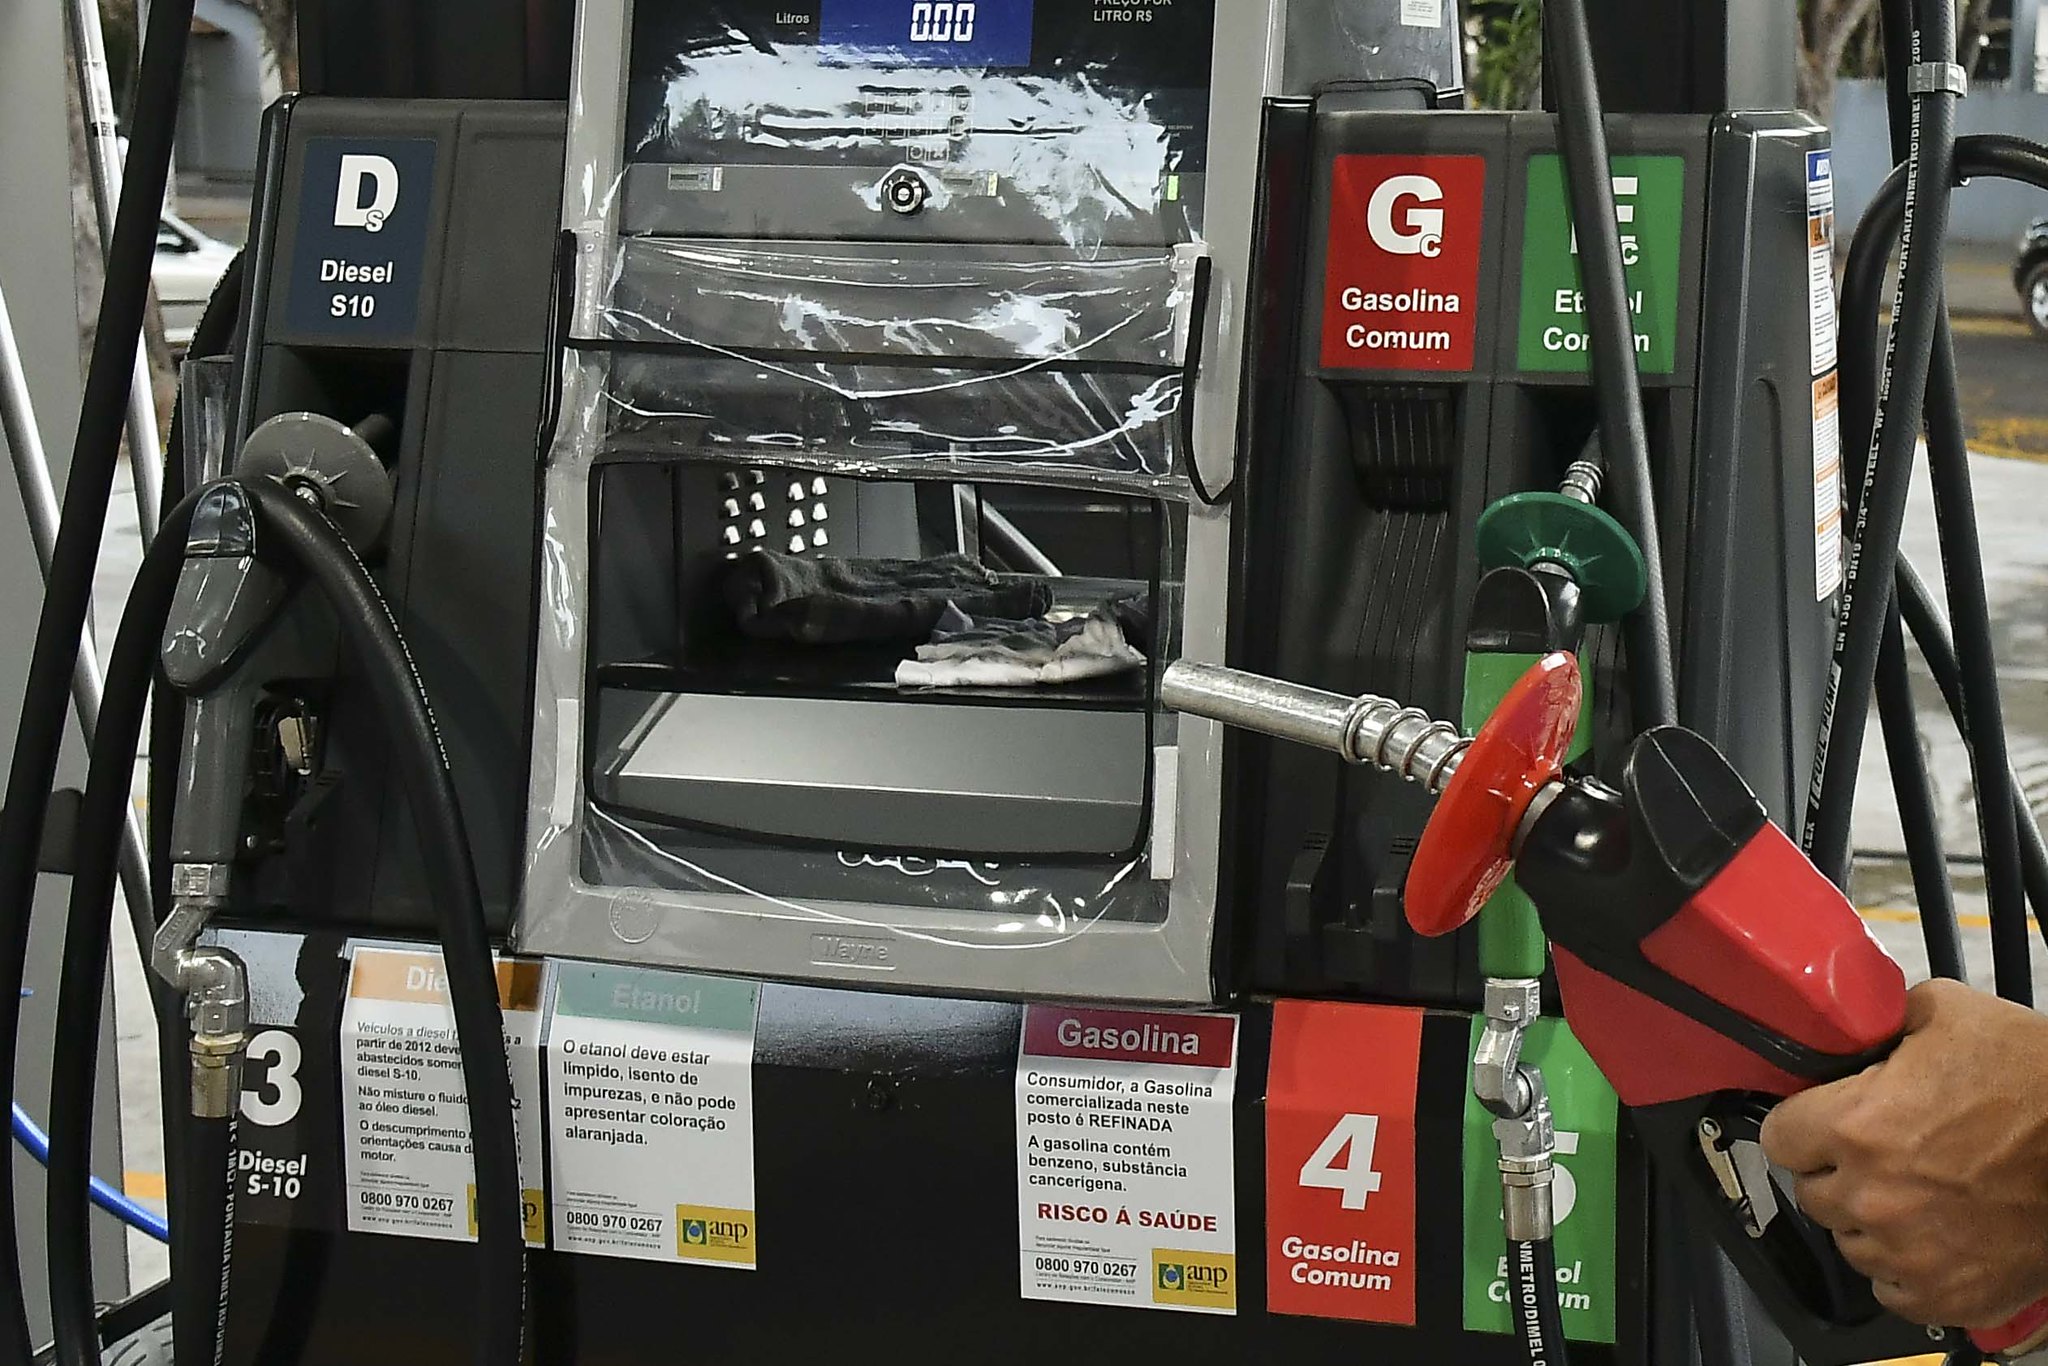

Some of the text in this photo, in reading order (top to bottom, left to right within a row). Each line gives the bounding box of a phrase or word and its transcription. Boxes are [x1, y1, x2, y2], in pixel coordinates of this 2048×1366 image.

[776, 13, 809, 25] Litros
[911, 3, 975, 41] 0.00
[1094, 10, 1153, 23] LITRO R$
[321, 259, 394, 283] Diesel
[330, 294, 375, 317] S10
[1341, 288, 1460, 313] Gasolina
[1346, 325, 1450, 350] Comum
[1835, 631, 1847, 652] EN
[612, 982, 701, 1014] Etanol
[406, 1027, 413, 1037] a
[416, 1027, 450, 1040] diesel
[1057, 1018, 1200, 1055] Gasolina
[356, 1037, 387, 1051] partir
[388, 1040, 402, 1051] de
[405, 1040, 432, 1054] 2012
[563, 1039, 711, 1066] O etanol deve estar
[357, 1052, 424, 1067] abastecidos
[240, 1030, 301, 1126] 3
[357, 1066, 421, 1082] diesel S-10.
[563, 1061, 699, 1086] límpido, isento de
[1027, 1071, 1213, 1098] Consumidor, a Gasolina
[358, 1085, 381, 1098] Não
[383, 1088, 425, 1102] misture
[428, 1093, 436, 1102] o
[564, 1082, 737, 1111] impurezas, e não pode
[1027, 1093, 1190, 1116] comercializada neste
[358, 1100, 439, 1117] ao óleo diesel.
[564, 1106, 727, 1133] apresentar coloração
[360, 1119, 369, 1131] O
[371, 1121, 466, 1140] descumprimento
[1027, 1111, 1173, 1133] posto é REFINADA
[360, 1136, 425, 1151] orientações
[428, 1142, 462, 1154] causa
[565, 1125, 648, 1146] alaranjada.
[1028, 1135, 1171, 1158] A gasolina contém
[238, 1150, 307, 1176] Diesel
[360, 1150, 397, 1163] motor.
[1028, 1153, 1188, 1178] benzeno, substância
[1299, 1113, 1382, 1210] 4
[247, 1174, 301, 1199] S-10
[1029, 1174, 1127, 1193] cancerígena.
[361, 1191, 392, 1206] 0800
[395, 1194, 419, 1209] 970
[422, 1197, 454, 1212] 0267
[567, 1211, 599, 1226] 0800
[602, 1214, 627, 1229] 970
[630, 1217, 663, 1232] 0267
[1038, 1203, 1217, 1233] RISCO Á SAÚDE
[709, 1220, 749, 1244] anp
[1281, 1236, 1400, 1267] Gasolina
[1036, 1257, 1137, 1278] 0800 970 0267
[1187, 1265, 1228, 1288] anp
[1291, 1262, 1392, 1291] Comum
[1519, 1241, 1543, 1358] NMETRO/DIMEL
